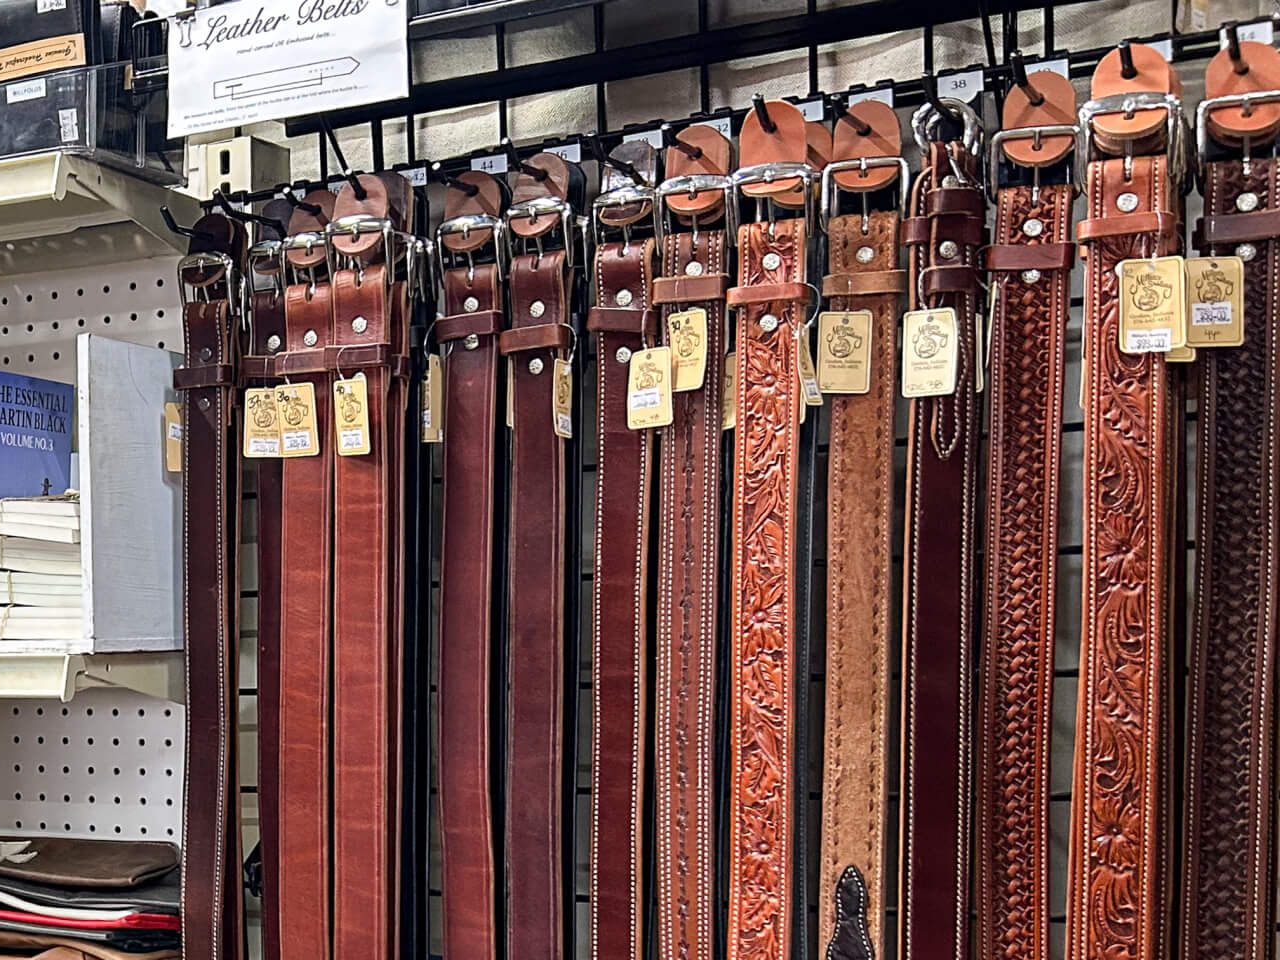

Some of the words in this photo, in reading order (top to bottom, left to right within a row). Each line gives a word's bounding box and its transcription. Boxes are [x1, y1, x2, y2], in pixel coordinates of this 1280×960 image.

[197, 7, 289, 50] Leather
[297, 0, 369, 25] Belts
[950, 79, 967, 90] 38
[479, 160, 494, 170] 44
[14, 387, 68, 413] ESSENTIAL
[34, 412, 66, 434] BLACK
[0, 431, 34, 449] VOLUME
